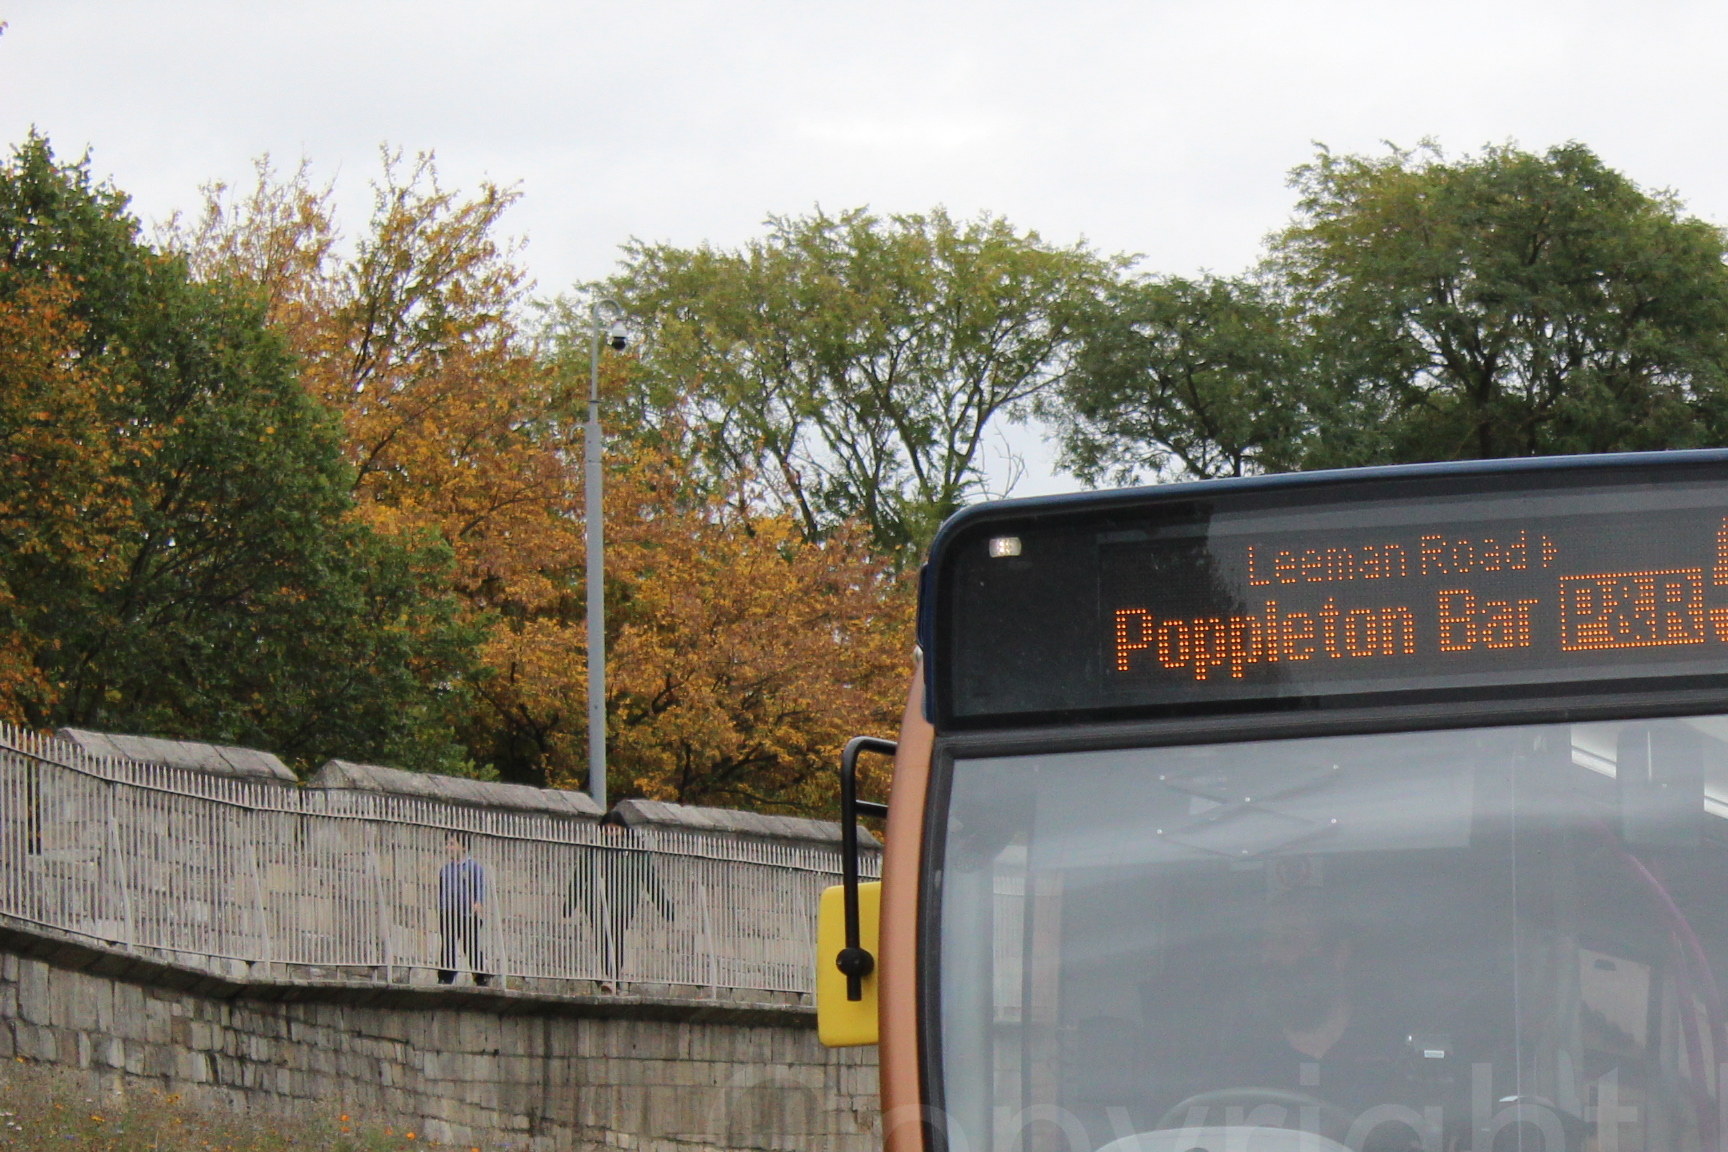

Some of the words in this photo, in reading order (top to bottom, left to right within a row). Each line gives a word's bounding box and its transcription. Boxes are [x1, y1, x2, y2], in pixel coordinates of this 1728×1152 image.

[1247, 543, 1407, 586] Leeman
[1420, 530, 1528, 577] Road
[1114, 597, 1415, 681] Poppleton
[1438, 588, 1540, 652] Bar
